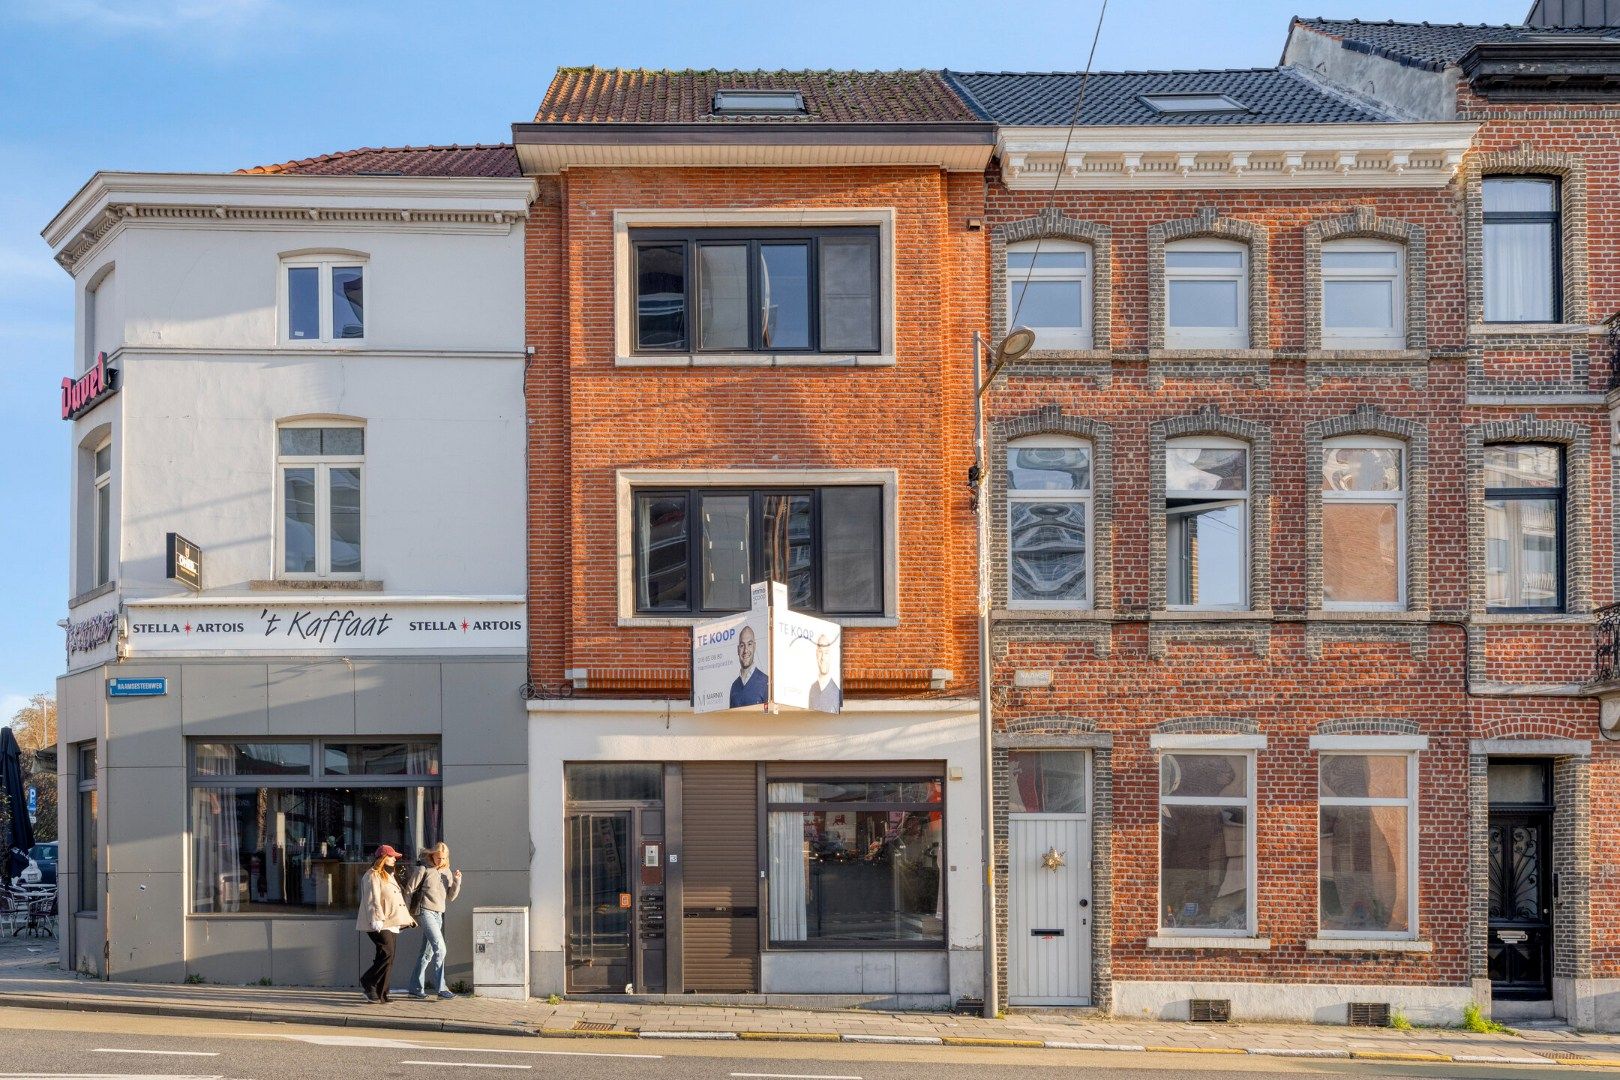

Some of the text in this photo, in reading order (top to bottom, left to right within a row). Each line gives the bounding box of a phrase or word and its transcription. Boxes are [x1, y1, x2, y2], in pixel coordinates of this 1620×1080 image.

[61, 351, 107, 418] Duvel
[132, 622, 244, 634] STELLA ARTOIS
[260, 609, 393, 643] 't Kaffaat
[409, 620, 521, 631] STELLA ARTOIS
[779, 622, 815, 640] TE KOOP
[698, 628, 736, 646] TE KOOP
[30, 788, 36, 803] P
